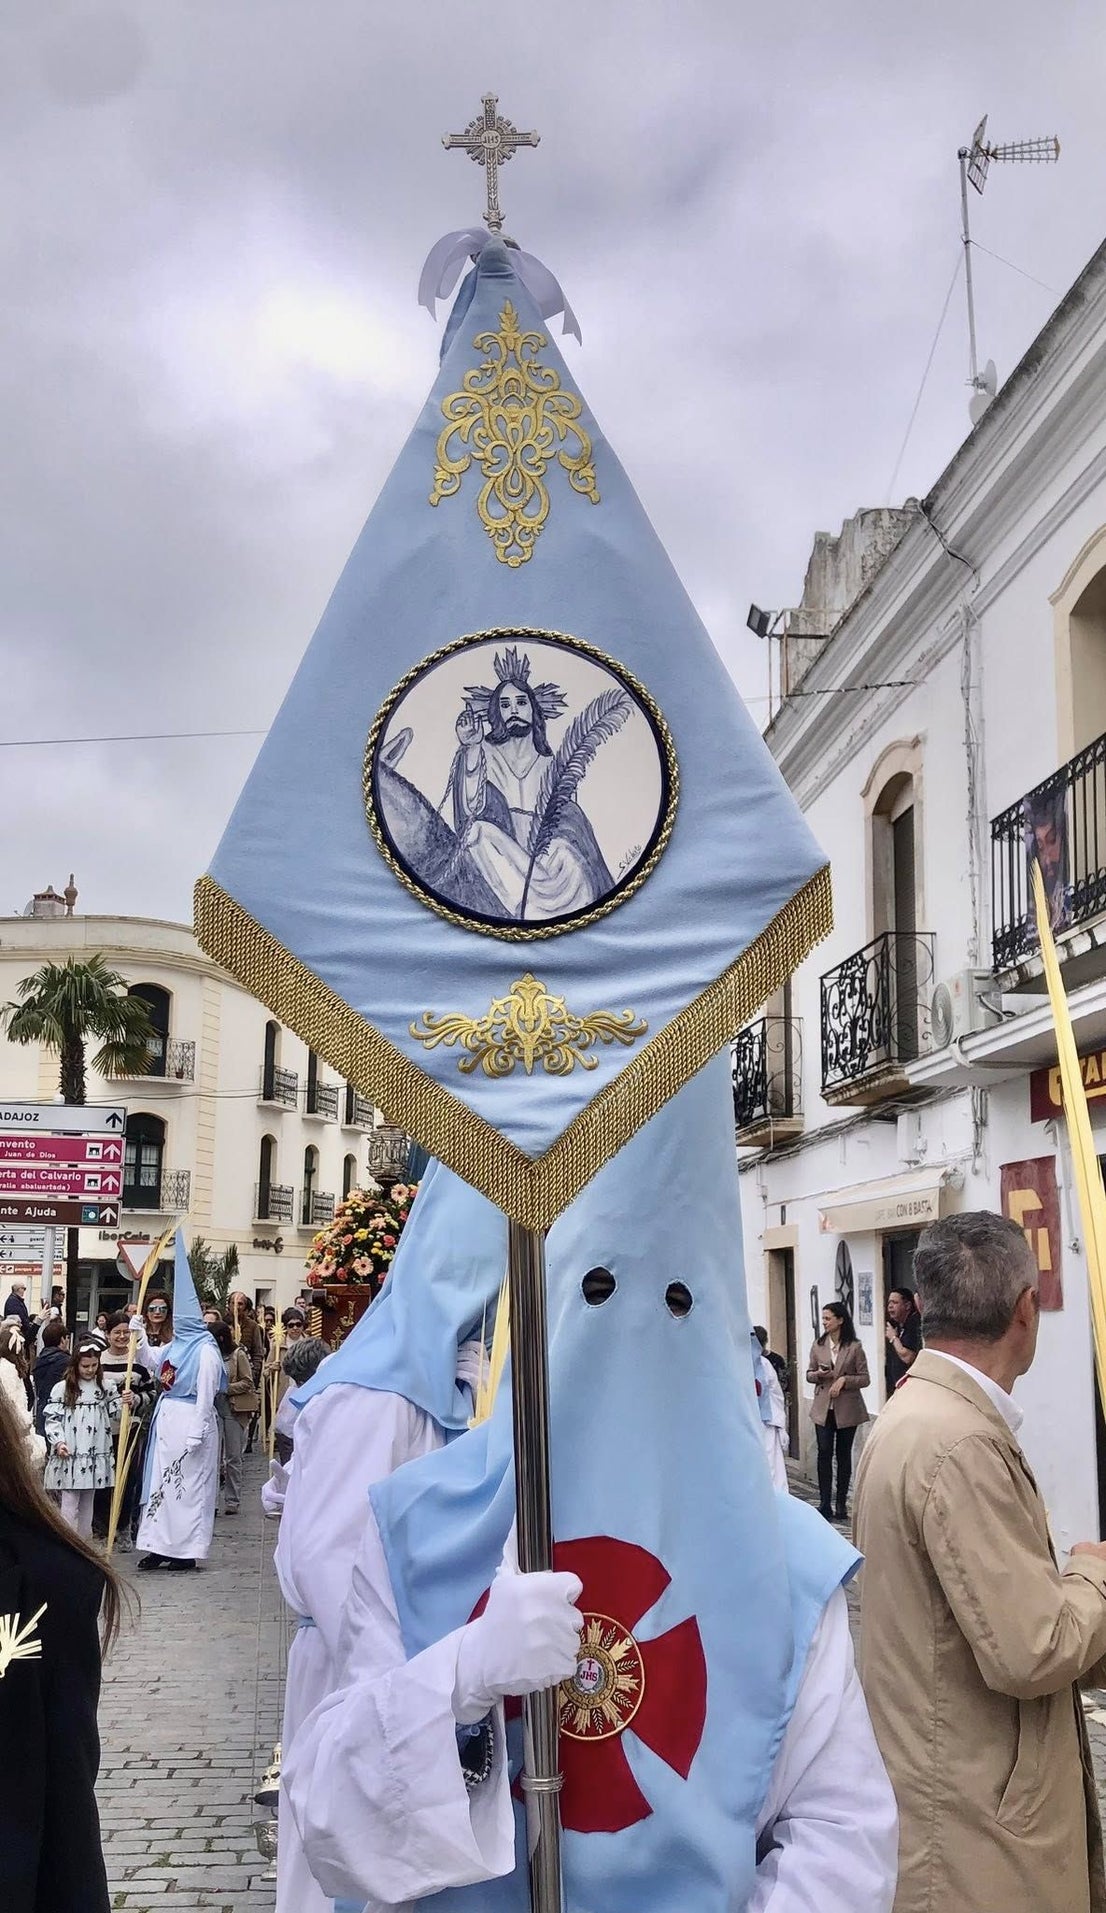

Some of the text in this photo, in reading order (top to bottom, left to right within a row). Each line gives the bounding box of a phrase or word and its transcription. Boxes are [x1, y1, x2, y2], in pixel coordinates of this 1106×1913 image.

[40, 1151, 56, 1159] Dios
[21, 1170, 36, 1179] del
[40, 1171, 81, 1181] Calvario
[21, 1182, 71, 1191] abaluartada)
[25, 1207, 57, 1217] Ajuda
[580, 1671, 598, 1682] JHS
